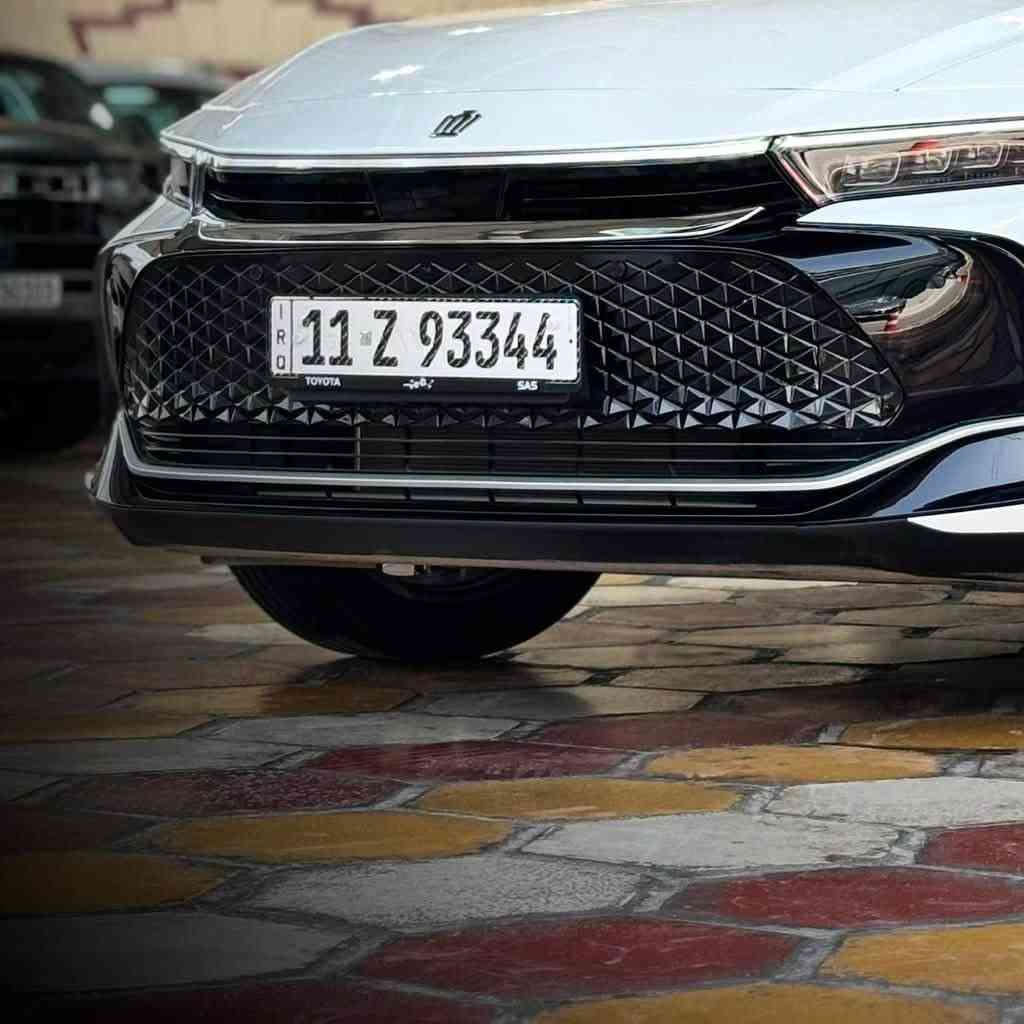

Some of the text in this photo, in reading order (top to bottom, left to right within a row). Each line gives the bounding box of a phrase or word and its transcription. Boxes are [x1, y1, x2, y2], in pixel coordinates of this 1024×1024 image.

[302, 309, 557, 370] 11 Z 93344
[305, 377, 341, 387] TOYOTA
[517, 380, 539, 391] SAS
